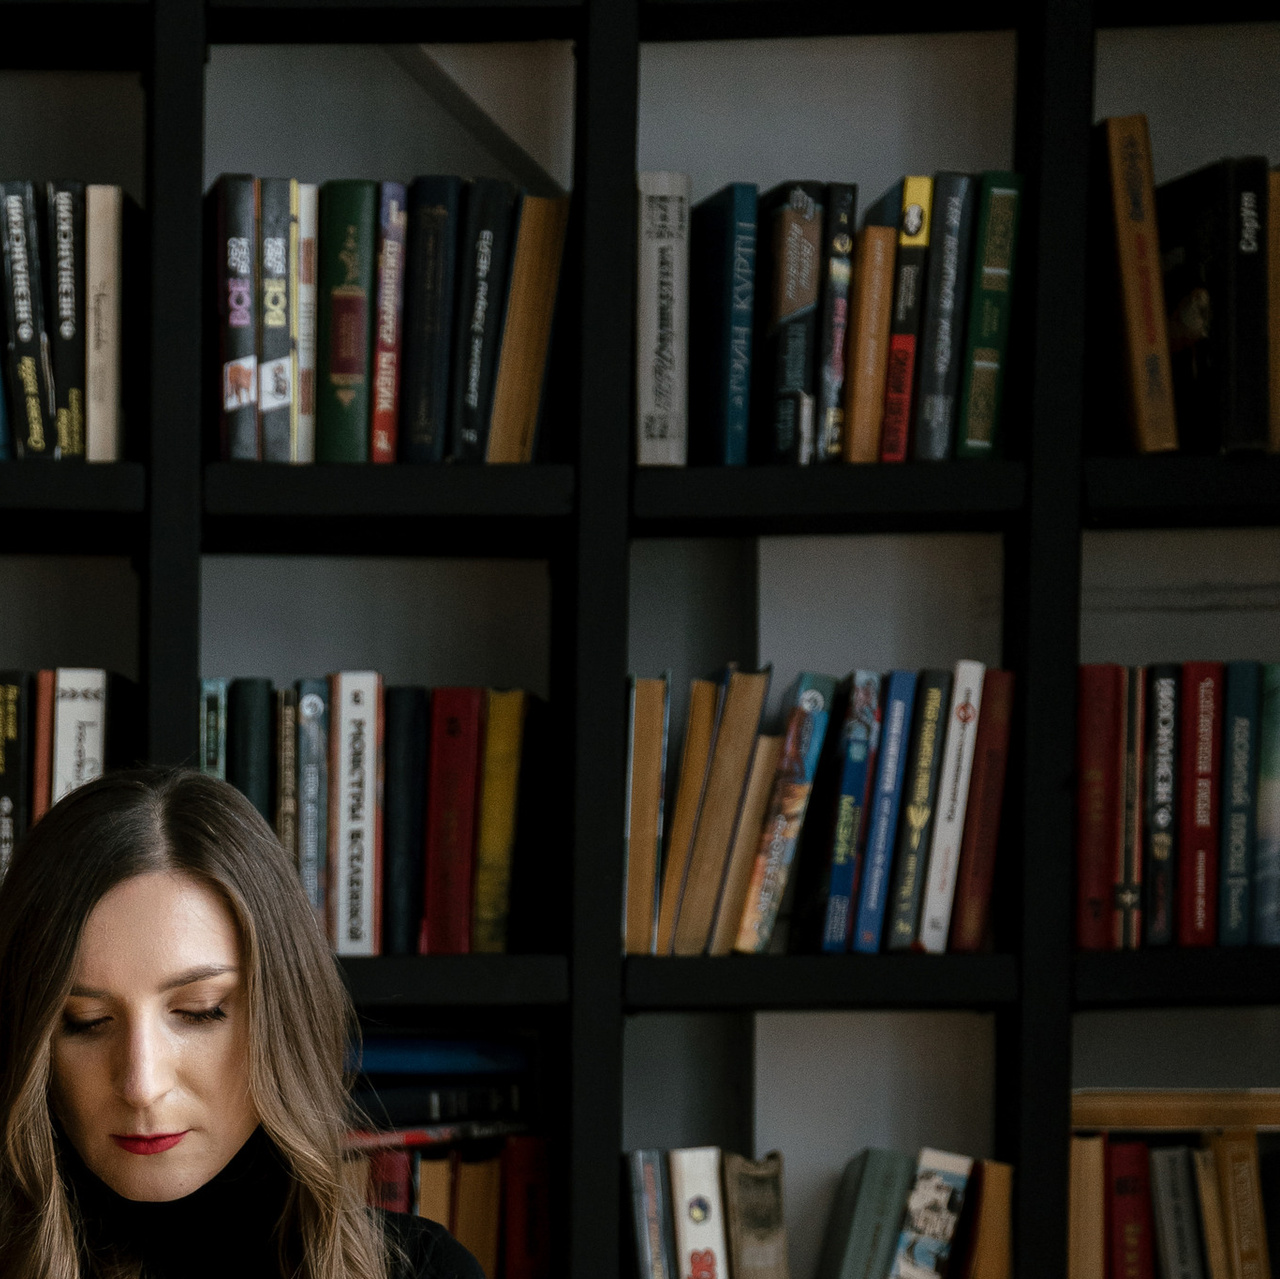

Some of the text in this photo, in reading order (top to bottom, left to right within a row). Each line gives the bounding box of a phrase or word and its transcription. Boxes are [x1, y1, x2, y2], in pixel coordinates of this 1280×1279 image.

[6, 193, 34, 342] Ф.НЕЗНАНСКИЙ
[55, 191, 75, 339] Ф.НЕЗНАНСКИЙ
[227, 277, 251, 326] ВСЕ
[263, 277, 286, 326] ВСЕ
[1153, 677, 1175, 827] Ф.НЕЗНАНСКИЙ
[349, 719, 366, 941] МОНСТРЫ ВСЕЛЕННОЙ
